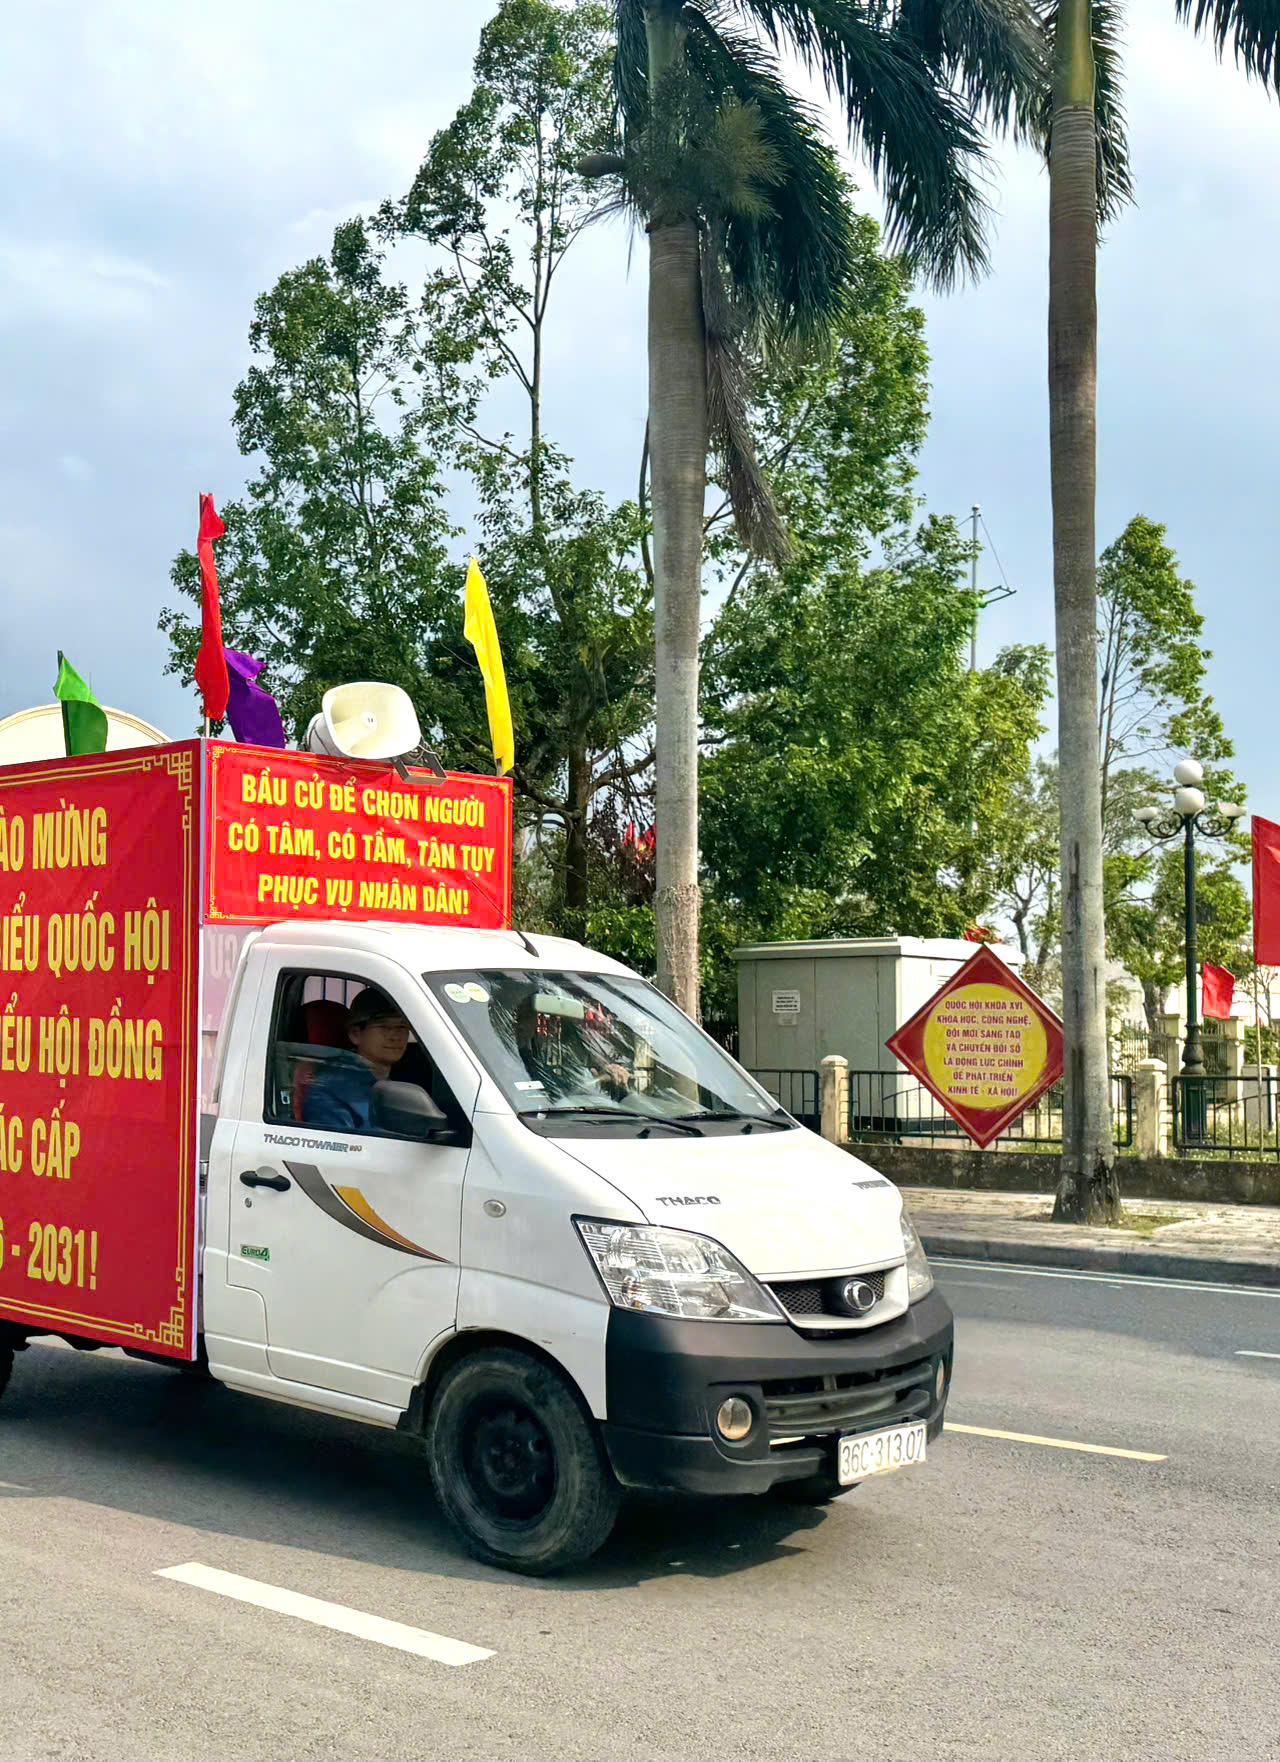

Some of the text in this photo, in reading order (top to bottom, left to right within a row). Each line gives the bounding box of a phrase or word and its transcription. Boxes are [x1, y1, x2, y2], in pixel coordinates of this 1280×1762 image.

[242, 766, 485, 827] BẦU CỬ ĐỂ CHỌN NGƯỜI
[33, 798, 107, 870] MỪNG
[228, 817, 494, 878] CÓ TÂM, CÓ TẦM, TẬN TỤY
[258, 874, 469, 915] PHỤC VỤ NHÂN DÂN!
[47, 890, 115, 978] QUỐC
[124, 897, 170, 985] HỘI
[38, 1004, 79, 1088] HỘI
[87, 997, 163, 1080] ĐỒNG
[30, 1099, 81, 1179] CẤP
[263, 1133, 300, 1147] THACO
[656, 1195, 721, 1206] THACO
[12, 1244, 20, 1257] -
[27, 1221, 97, 1290] 2031!
